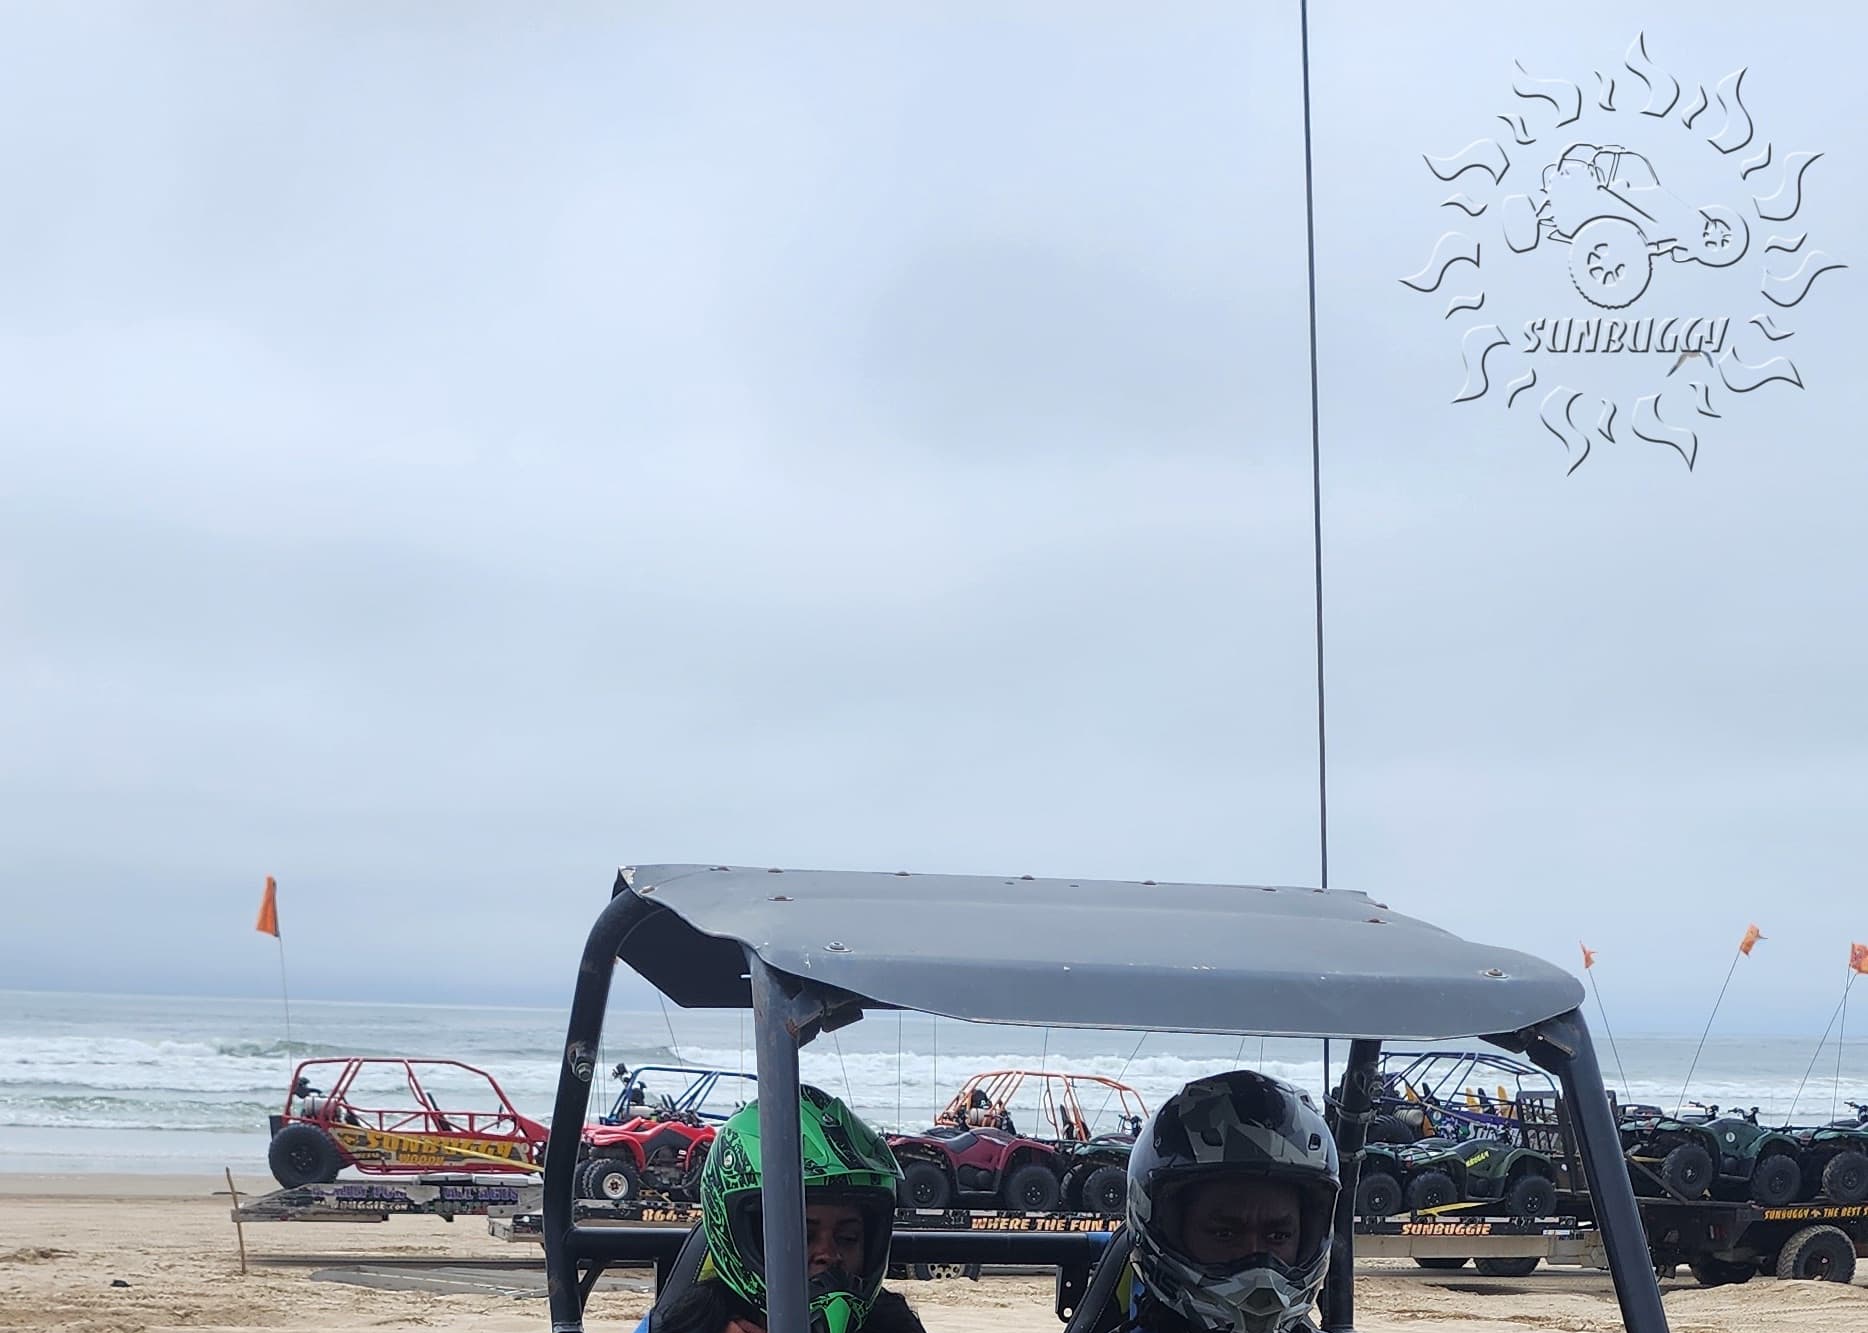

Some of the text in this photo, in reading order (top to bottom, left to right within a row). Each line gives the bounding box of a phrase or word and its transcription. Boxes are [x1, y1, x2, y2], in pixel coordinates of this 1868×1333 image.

[1764, 1208, 1810, 1220] SUNBUGGY
[1823, 1207, 1839, 1218] THE
[1841, 1206, 1862, 1217] BEST
[971, 1217, 1030, 1230] WHERE
[1035, 1217, 1066, 1231] THE
[1070, 1218, 1104, 1231] FUN
[1401, 1222, 1493, 1237] SUNBUGGIE
